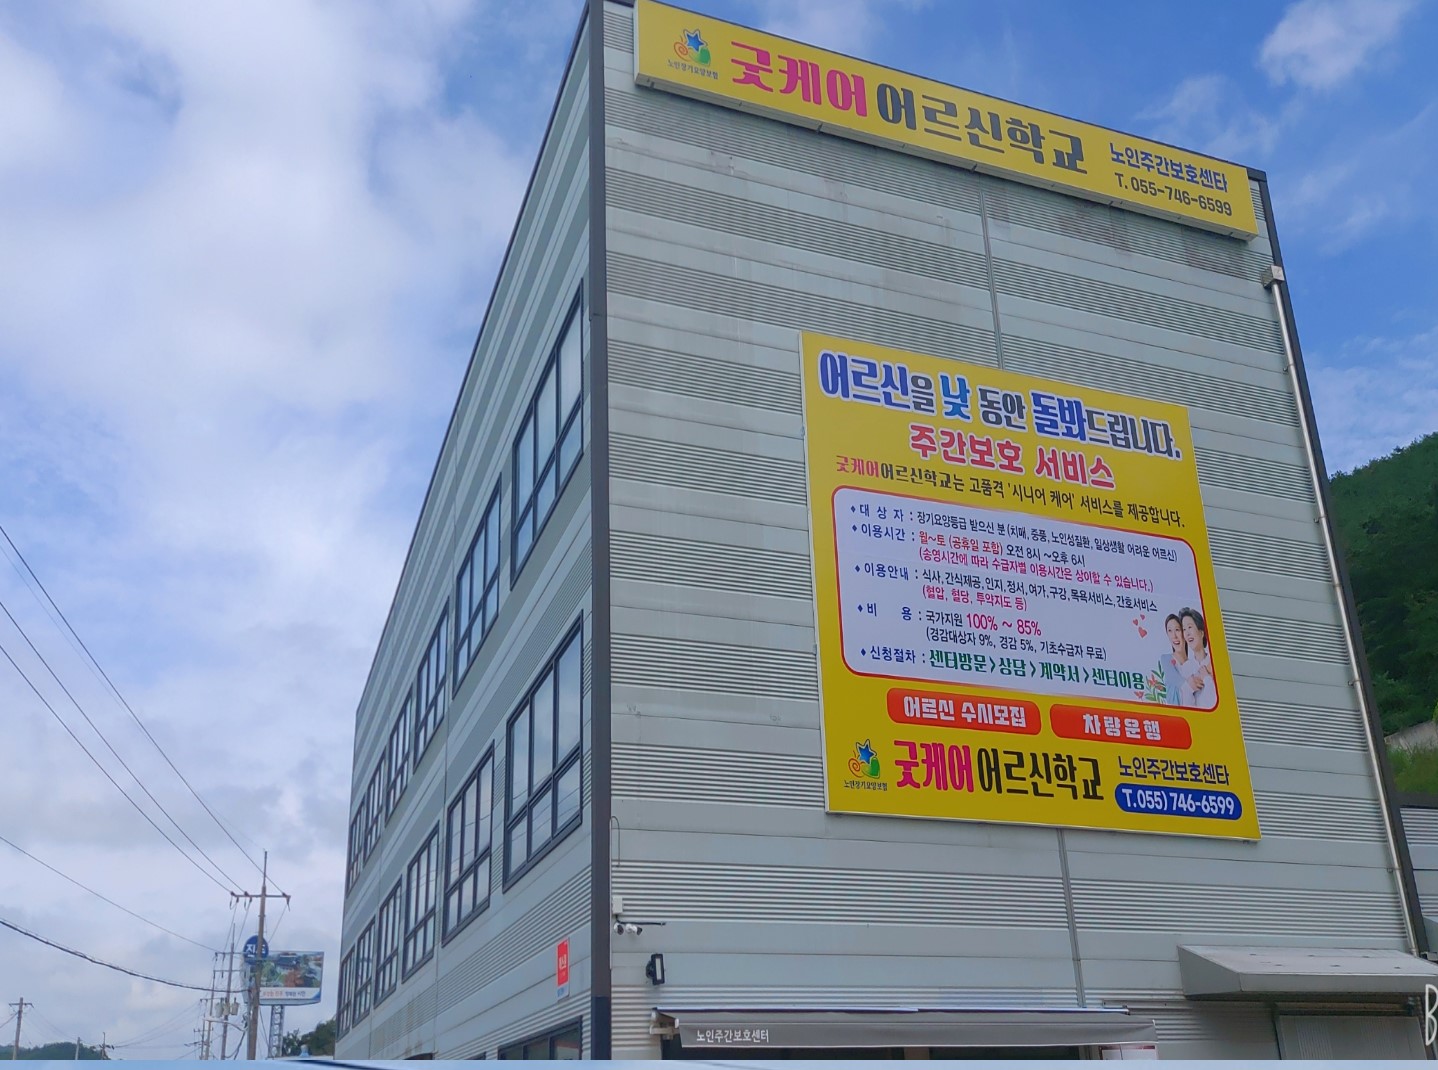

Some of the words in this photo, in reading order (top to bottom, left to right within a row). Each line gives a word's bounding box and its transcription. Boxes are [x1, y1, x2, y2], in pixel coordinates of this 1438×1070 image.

[731, 41, 868, 118] 굿케어
[877, 82, 1087, 174] 어르신학교
[1110, 142, 1228, 192] 노인주간보호센타
[1131, 177, 1232, 216] 055-746-6599
[820, 352, 935, 413] 어르신을
[940, 375, 970, 419] 낮
[978, 388, 1026, 429] 동안
[1031, 392, 1181, 458] 돌봐드립니다.
[910, 424, 1023, 473] 주간보호
[1035, 447, 1114, 488] 서비스
[969, 477, 1005, 498] 고품격
[1081, 496, 1123, 518] 서비스를
[1128, 503, 1185, 528] 제공합니다.
[862, 523, 905, 541] 이용시간
[1006, 545, 1023, 558] 오전
[1026, 547, 1041, 561] 8시
[1071, 554, 1085, 568] 6시
[917, 511, 967, 531] 장기요양등급
[970, 518, 995, 535] 받으신
[997, 523, 1005, 536] 분
[1127, 543, 1150, 558] 어려운
[864, 562, 909, 581] 이용안내
[972, 555, 989, 570] 따라
[992, 558, 1027, 575] 수급자별
[1030, 564, 1072, 581] 이용시간은
[1075, 570, 1101, 585] 상이할
[1103, 574, 1112, 586] 수
[977, 592, 1012, 608] 투약지도
[925, 610, 963, 628] 국가지원
[966, 613, 998, 631] 100%
[1017, 619, 1042, 636] 85%
[870, 645, 916, 664] 신청절차
[999, 636, 1017, 651] 경감
[1040, 641, 1084, 657] 기초수급자
[904, 696, 955, 721] 어르신
[962, 702, 1027, 728] 수시모집
[894, 740, 974, 793] 굿케어
[978, 748, 1104, 800] 어르신학교
[1118, 755, 1230, 785] 노인주간보호센타
[696, 1029, 769, 1043] 노인주간보호센터
